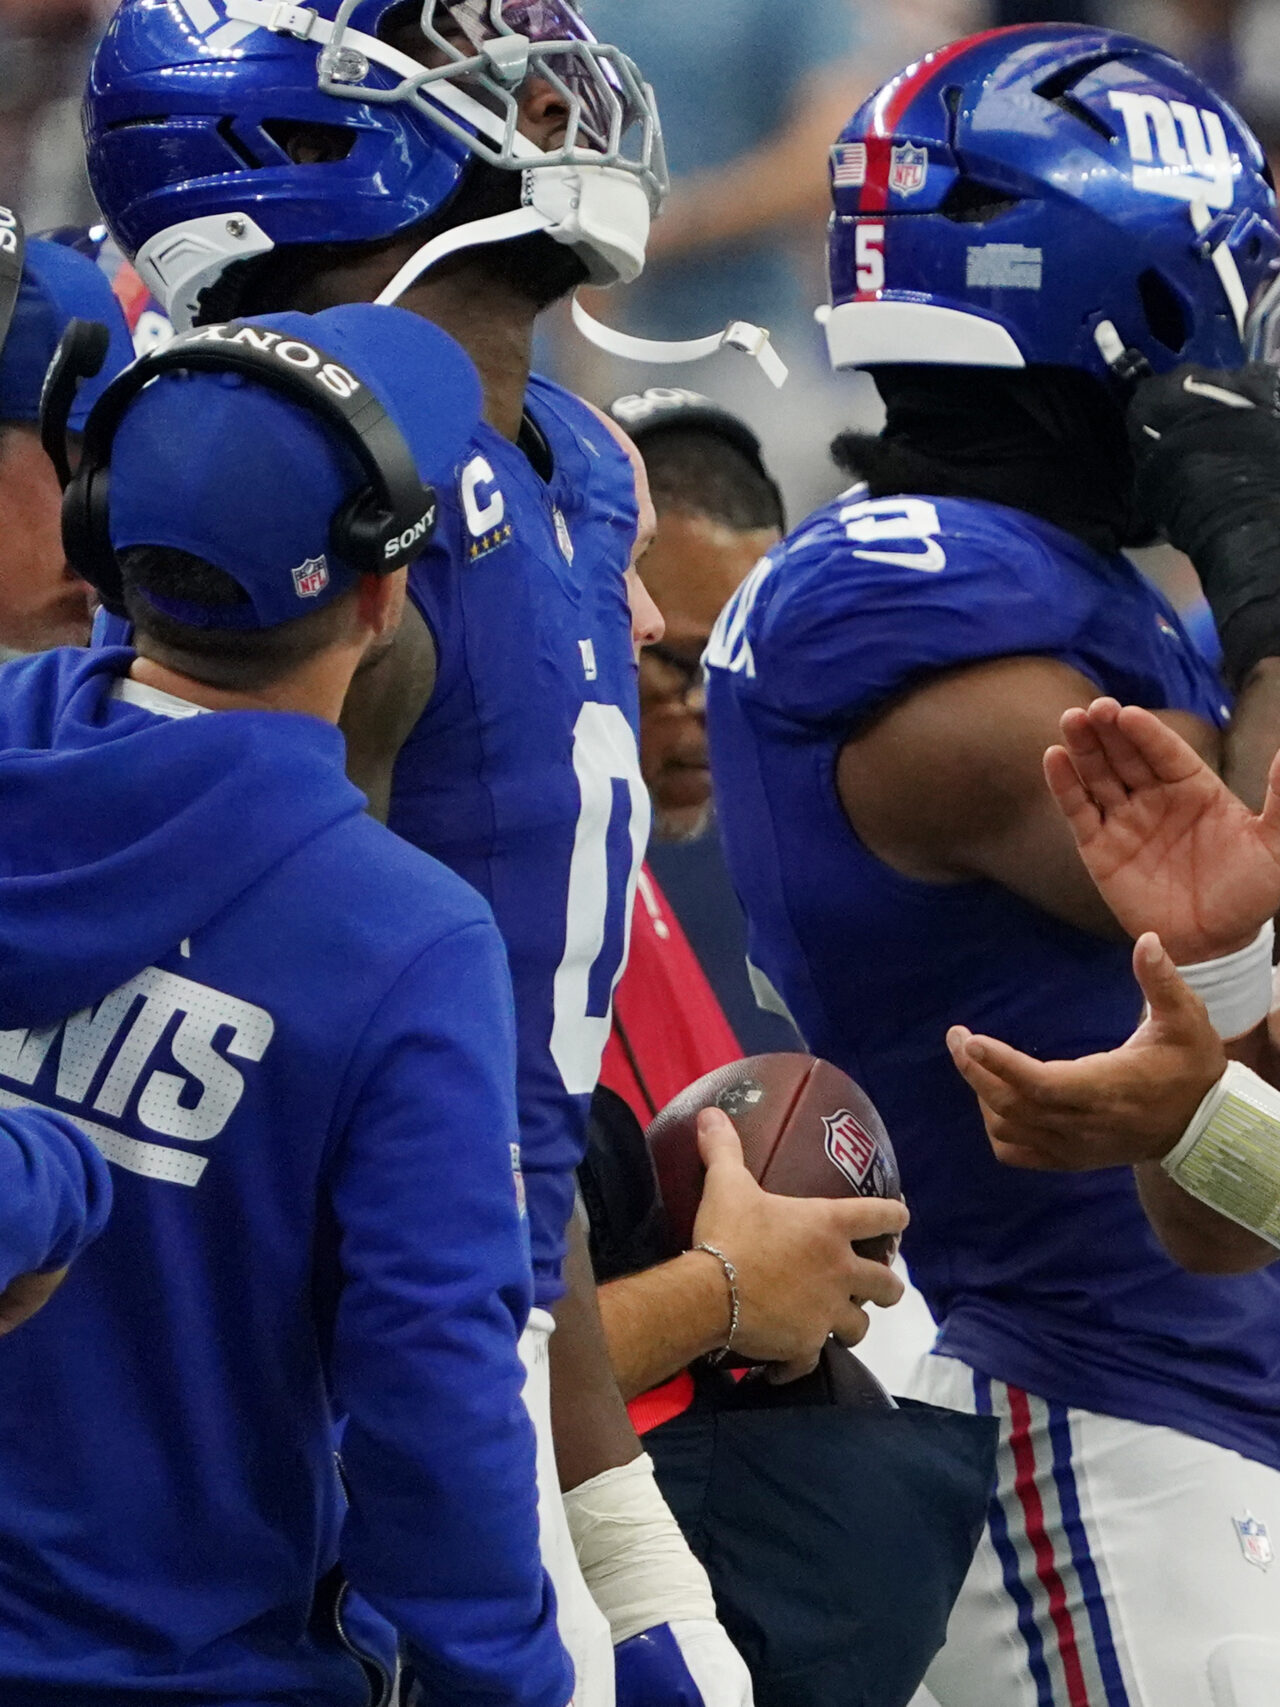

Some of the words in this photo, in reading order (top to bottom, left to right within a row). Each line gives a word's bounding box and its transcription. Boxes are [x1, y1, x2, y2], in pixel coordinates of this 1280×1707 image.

[894, 165, 919, 186] NFL
[855, 224, 885, 290] 5
[185, 325, 360, 398] SONY
[461, 455, 505, 537] C
[383, 504, 436, 559] SONY
[299, 571, 326, 594] NFL
[549, 701, 652, 1095] 0
[834, 1118, 877, 1177] NFL
